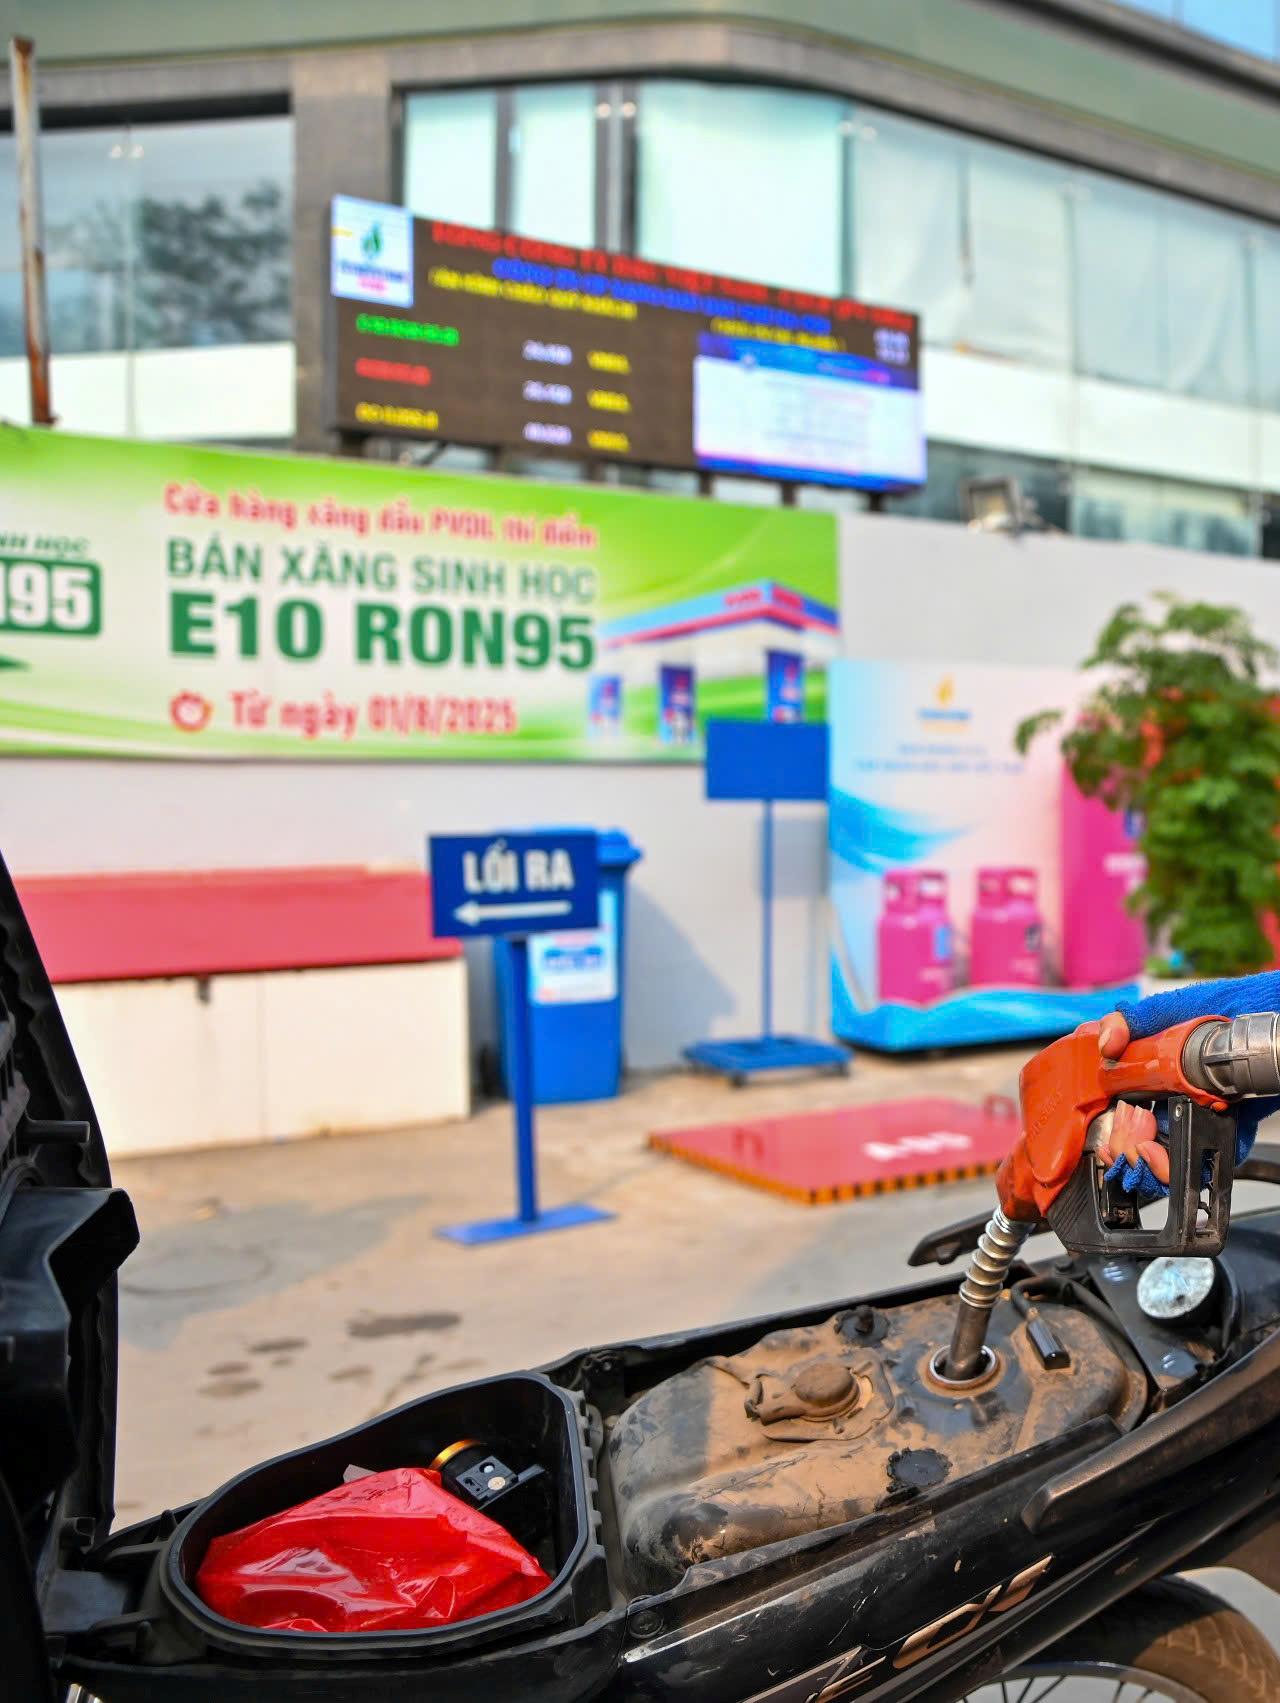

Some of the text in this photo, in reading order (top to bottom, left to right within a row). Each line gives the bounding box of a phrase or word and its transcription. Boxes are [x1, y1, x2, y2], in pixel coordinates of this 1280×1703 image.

[229, 488, 298, 531] hàng
[167, 531, 263, 584] BÁN
[280, 541, 397, 592] XĂNG
[411, 554, 506, 595] SINH
[0, 560, 94, 630] 95
[170, 591, 596, 671] E10 RON95
[279, 689, 359, 742] ngày
[524, 848, 575, 891] RA
